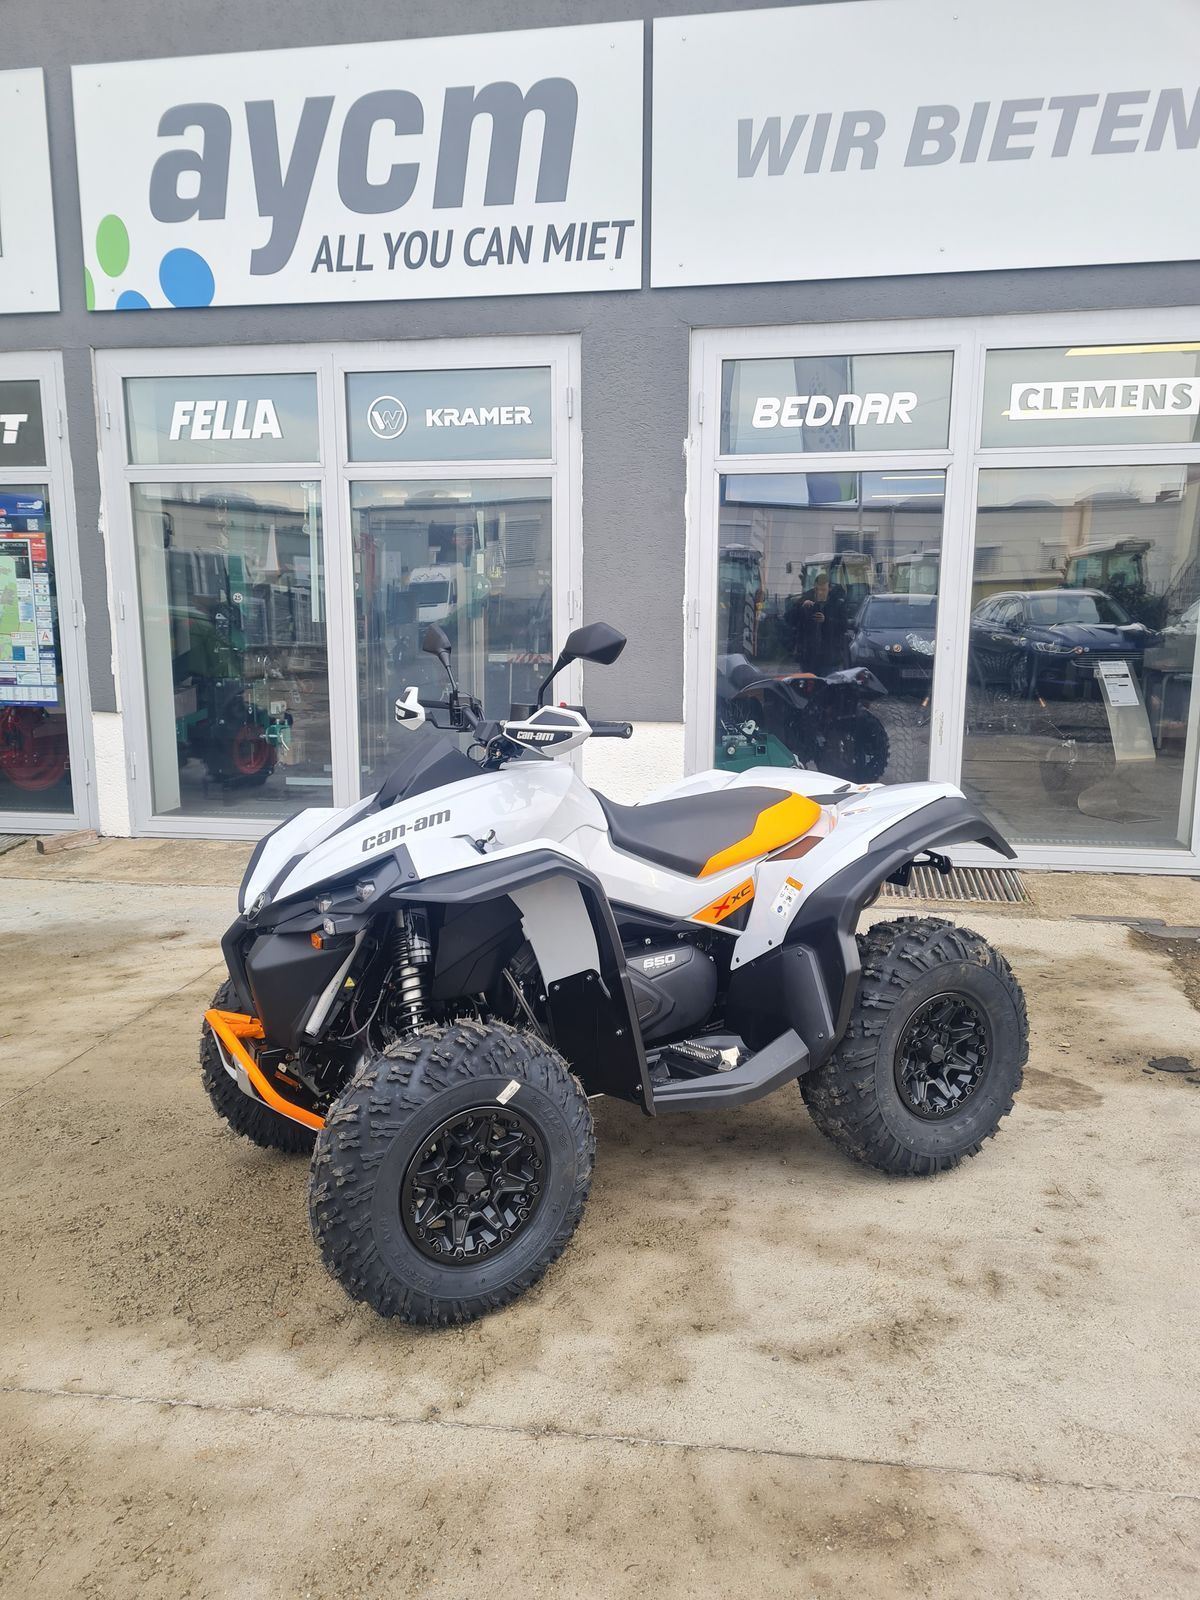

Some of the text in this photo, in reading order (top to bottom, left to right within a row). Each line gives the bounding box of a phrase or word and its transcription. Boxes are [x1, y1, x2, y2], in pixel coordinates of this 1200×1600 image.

[737, 87, 1200, 179] WIR BIETEN
[149, 77, 579, 276] aycm
[311, 220, 635, 274] ALL YOU CAN MIET
[425, 406, 533, 427] KRAMER
[751, 391, 918, 429] BEDNAR
[1018, 383, 1193, 410] CLEMENS
[169, 399, 283, 441] FELLA
[516, 731, 555, 741] can-am
[361, 809, 451, 852] can-am
[643, 954, 676, 969] 650
